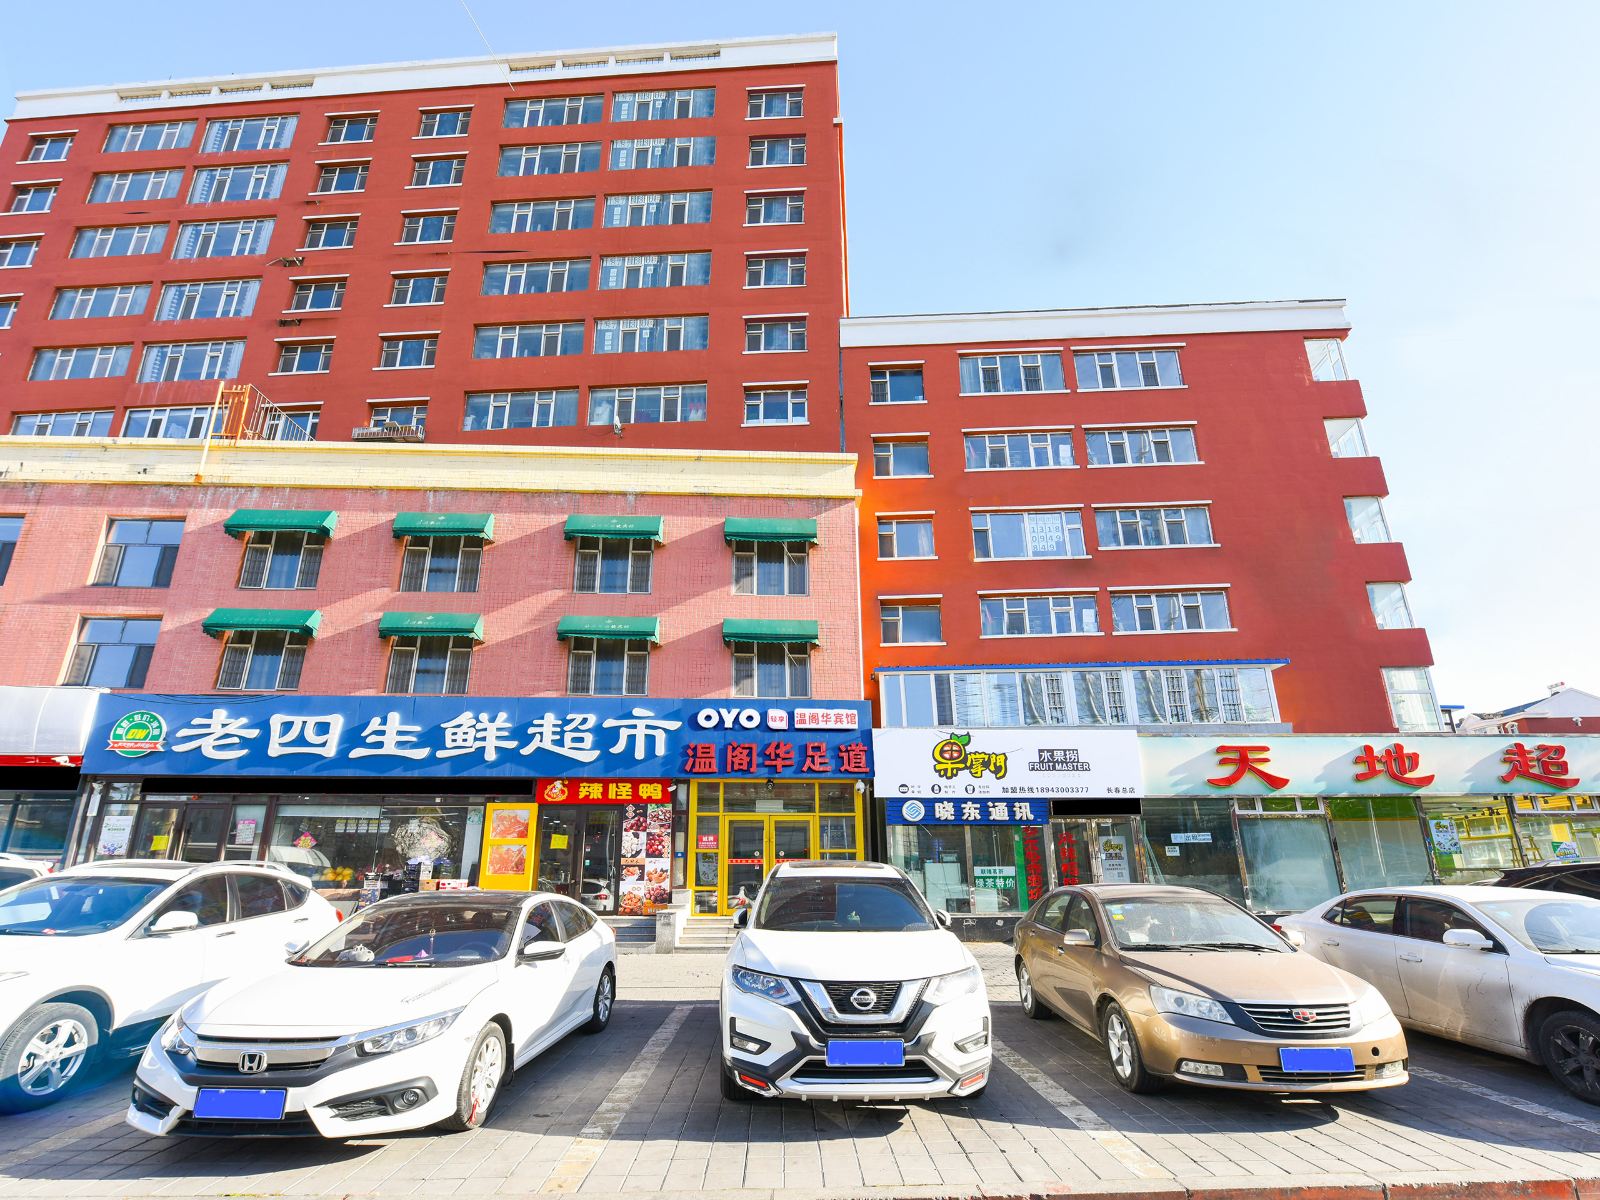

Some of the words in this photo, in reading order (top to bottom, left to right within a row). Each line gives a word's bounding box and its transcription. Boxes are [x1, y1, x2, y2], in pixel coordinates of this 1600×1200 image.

[1032, 534, 1061, 543] 0949
[697, 708, 761, 729] OYO
[795, 712, 857, 725] 温阁华宾馆
[171, 707, 683, 763] 老四生鲜超市
[684, 741, 870, 773] 温阁华足道
[1039, 750, 1079, 762] 水果捞
[1029, 762, 1054, 771] FRUIT
[1055, 762, 1090, 771] MASTER
[1206, 742, 1581, 790] 天地超
[578, 783, 663, 800] 辣怪鸭
[934, 801, 1034, 822] 晓东通讯
[975, 878, 1015, 889] 绿茶特价
